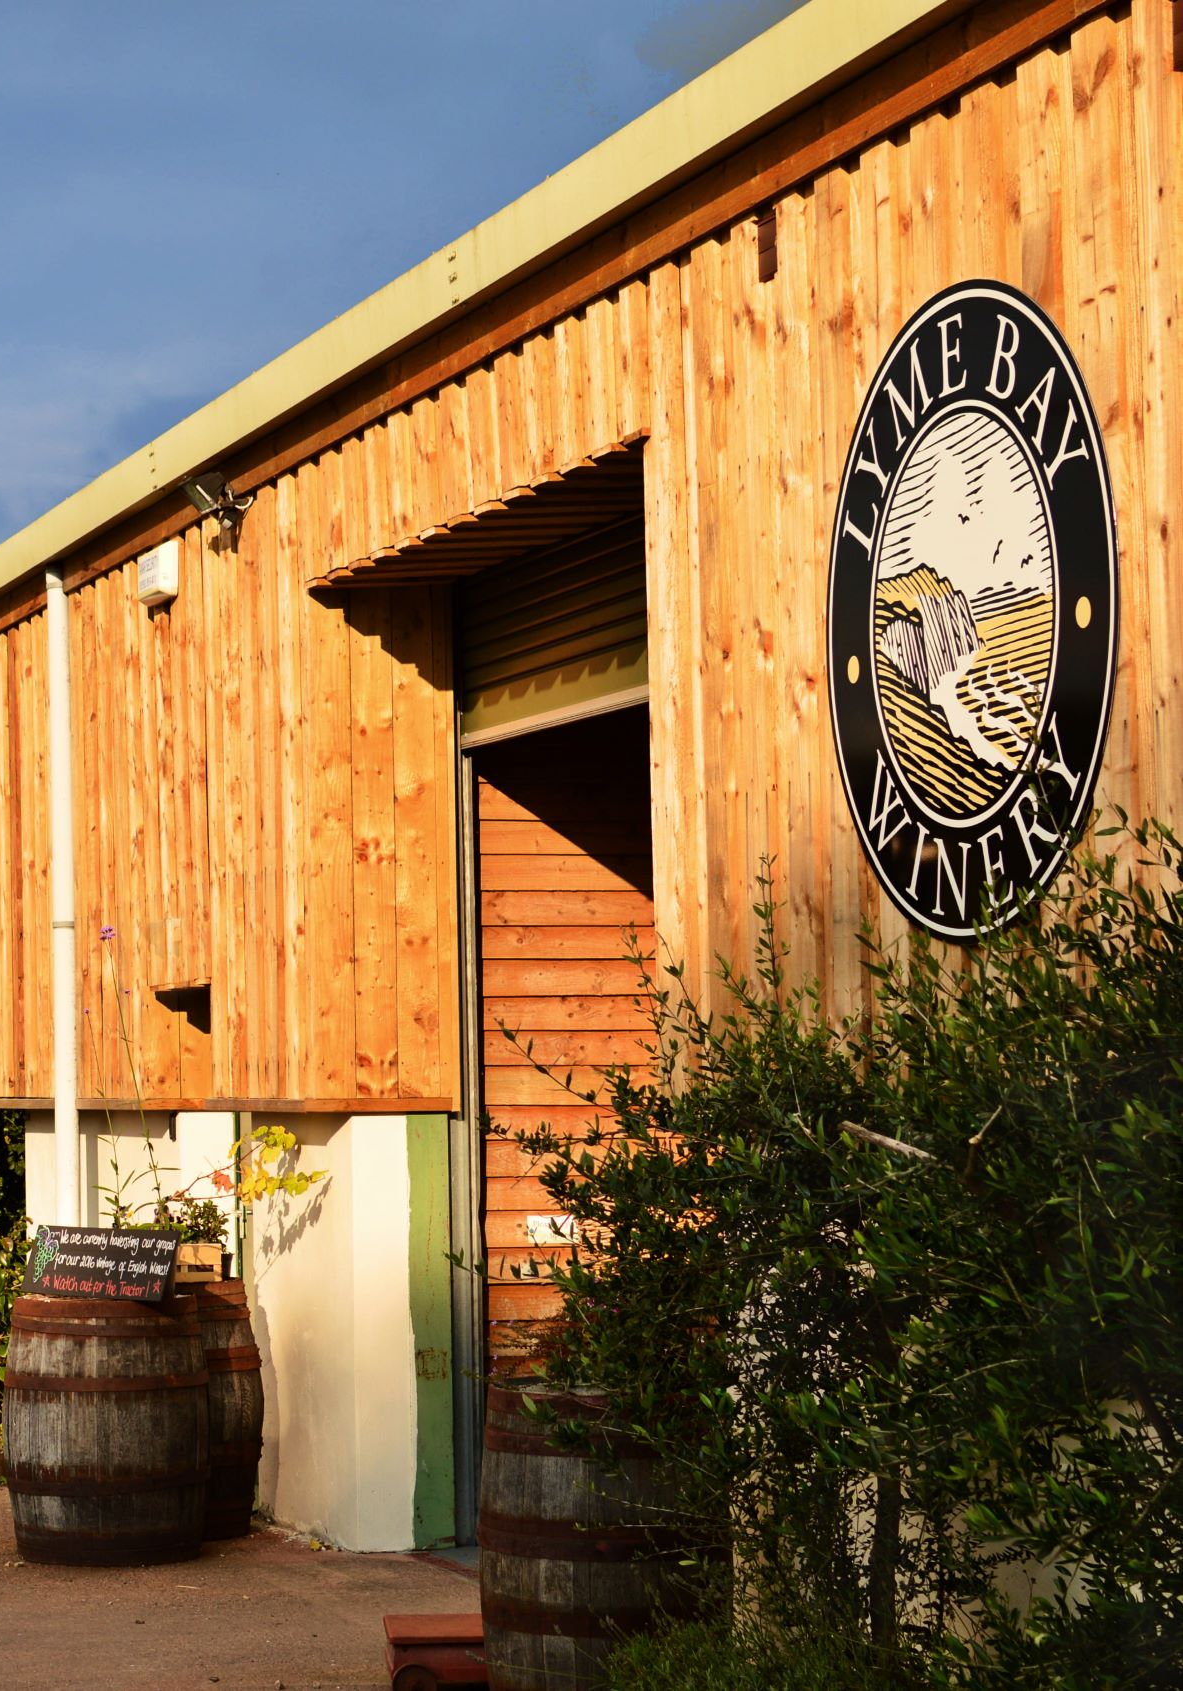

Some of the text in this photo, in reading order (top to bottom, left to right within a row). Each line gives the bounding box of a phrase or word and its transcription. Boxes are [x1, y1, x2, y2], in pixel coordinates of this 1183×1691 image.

[842, 312, 1089, 562] LYME BAY
[867, 711, 1083, 922] WINERY
[60, 1229, 68, 1244] We
[70, 1234, 82, 1244] are
[142, 1238, 155, 1248] our
[54, 1253, 66, 1270] for
[66, 1255, 79, 1265] our
[119, 1261, 126, 1279] of
[54, 1275, 77, 1291] Watch
[80, 1277, 92, 1291] out
[93, 1281, 104, 1294] for
[106, 1280, 116, 1295] the
